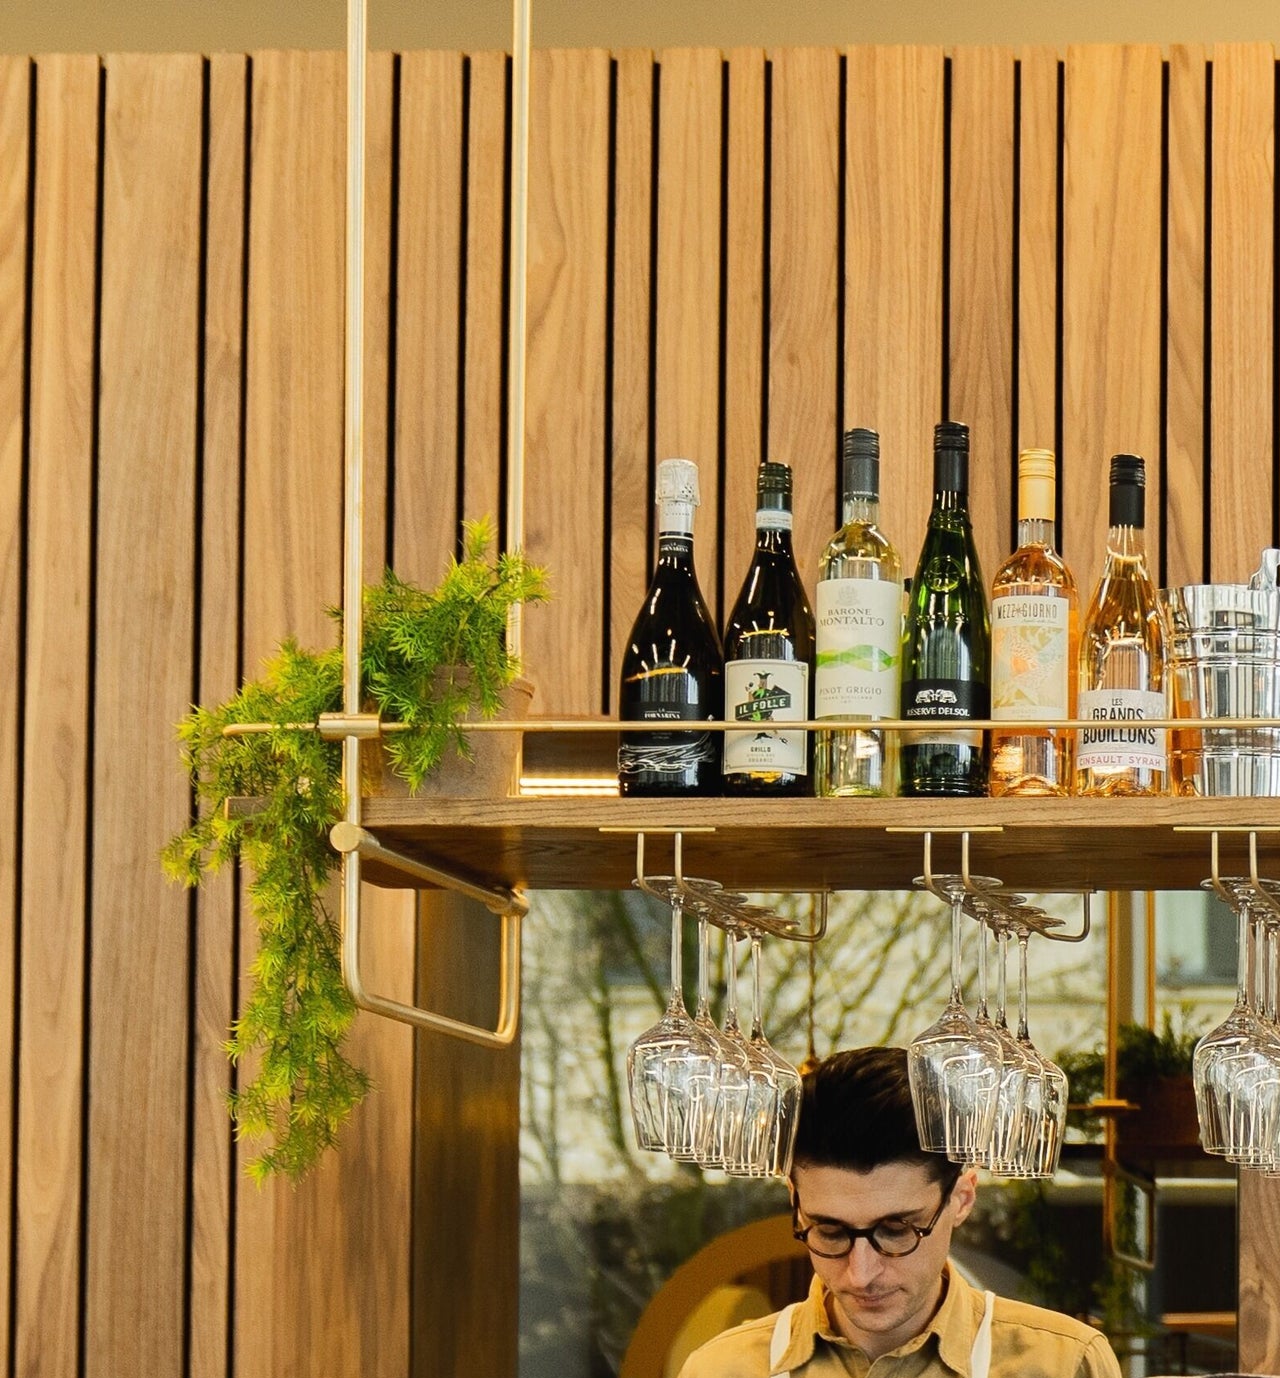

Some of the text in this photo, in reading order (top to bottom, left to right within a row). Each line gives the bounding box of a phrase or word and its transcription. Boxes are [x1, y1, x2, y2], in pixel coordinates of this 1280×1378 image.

[828, 607, 872, 616] BARONE
[819, 616, 885, 627] MONTALTO
[819, 686, 882, 696] PINOT GRIGIO
[740, 698, 786, 714] IL FOLLE
[1112, 698, 1123, 706] LES
[1092, 707, 1144, 721] GRANDS
[1083, 727, 1156, 745] BOUILLONS
[1129, 756, 1160, 767] SYRAH
